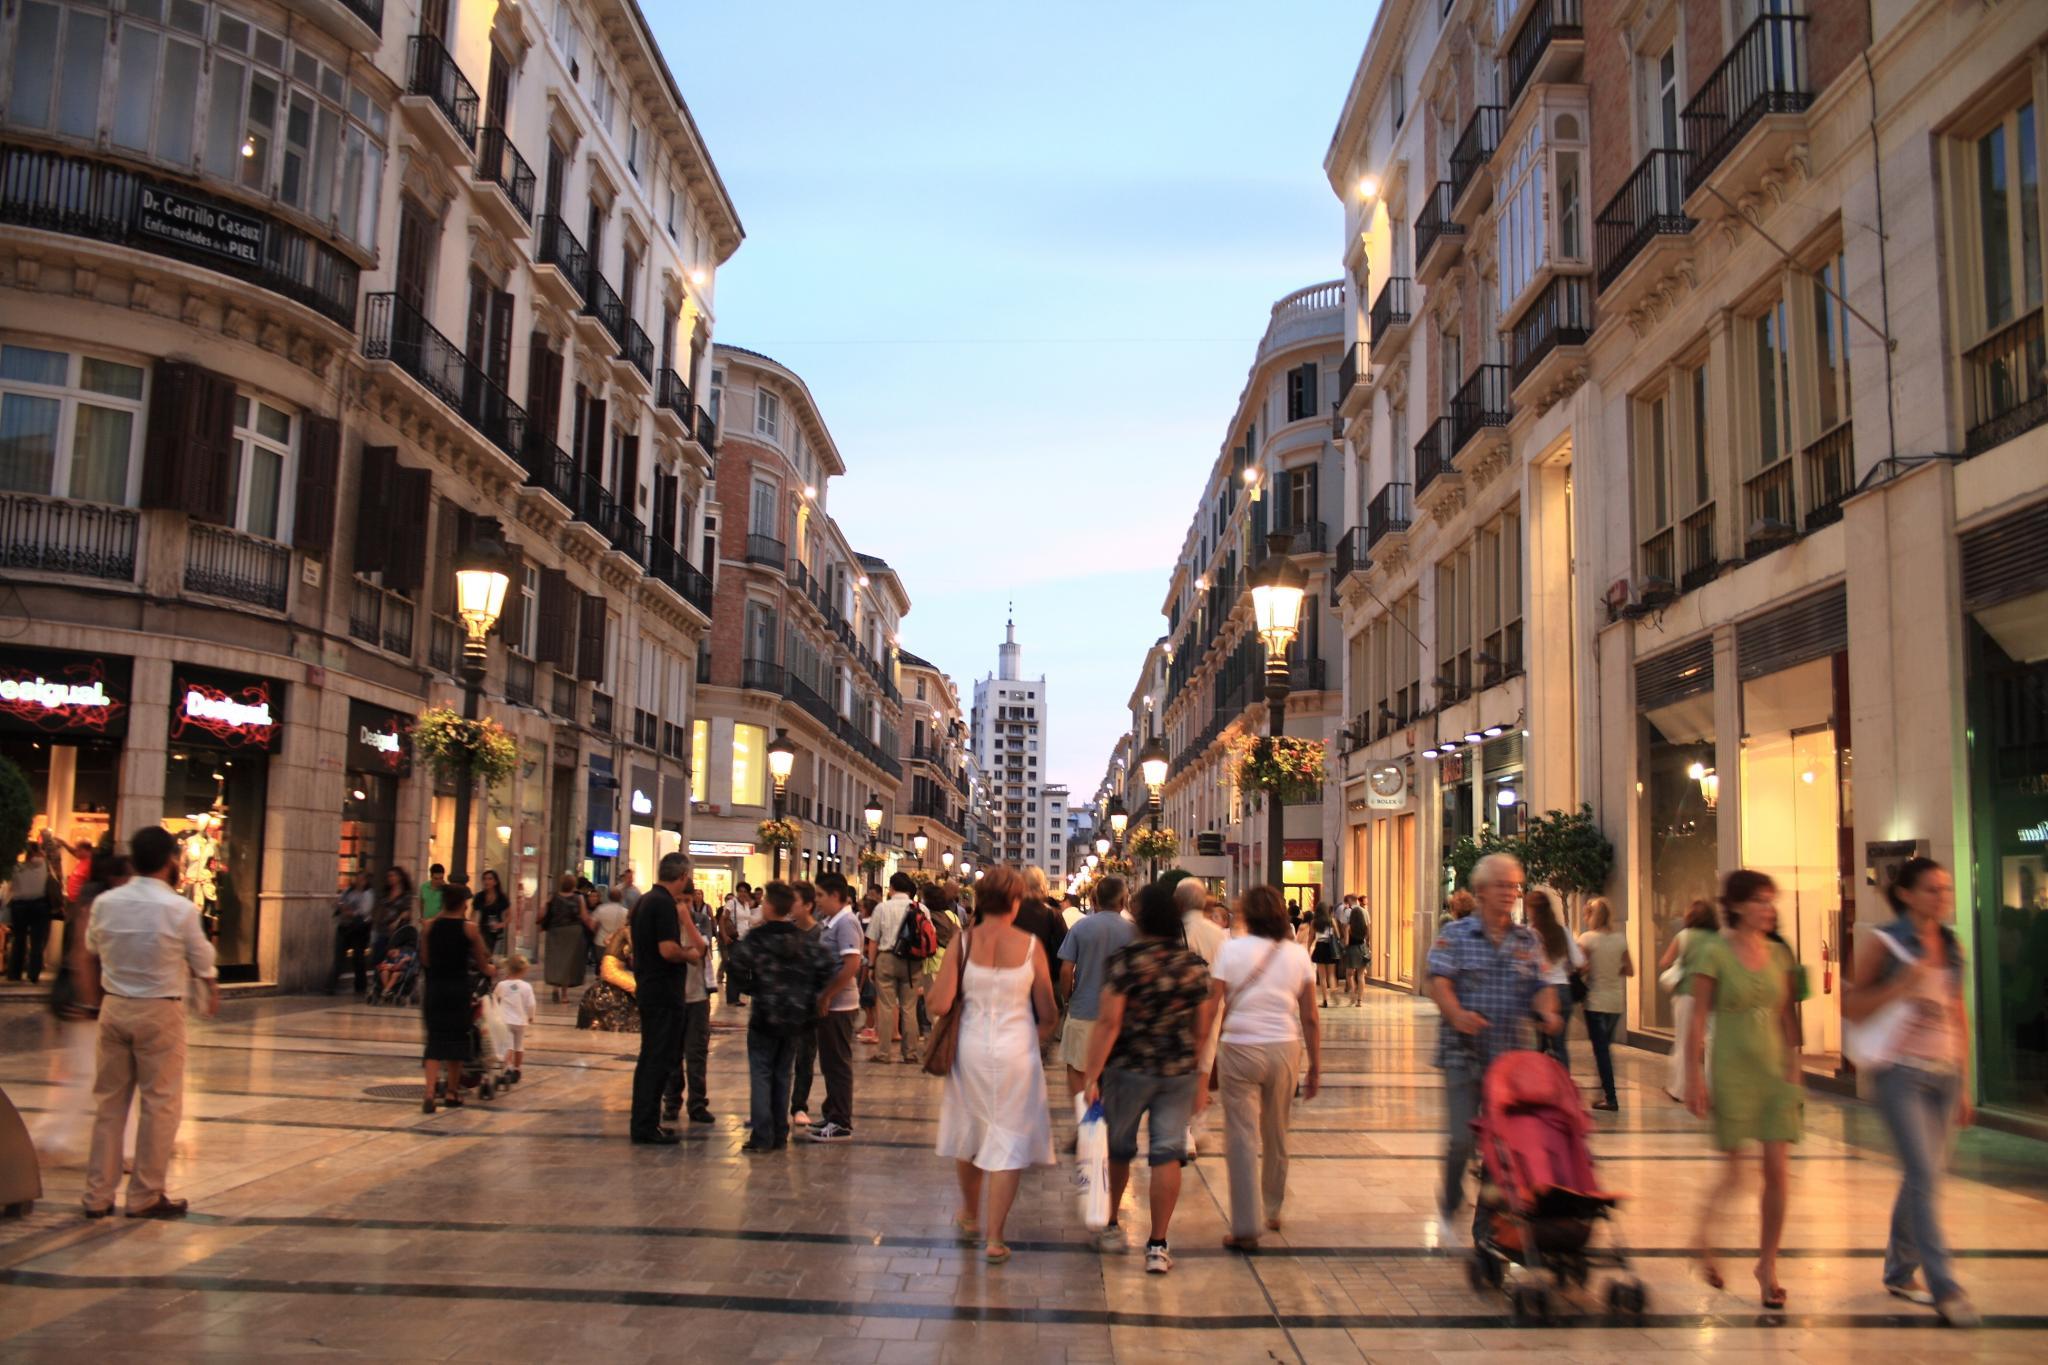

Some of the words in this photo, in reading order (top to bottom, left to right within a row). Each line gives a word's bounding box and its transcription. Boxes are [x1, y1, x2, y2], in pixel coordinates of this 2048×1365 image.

[143, 190, 160, 211] Dr.
[164, 197, 214, 228] Carrillo
[217, 214, 260, 241] Casaux
[144, 216, 212, 247] Enfermedades
[229, 241, 257, 261] PIEL
[0, 677, 110, 707] esigual.
